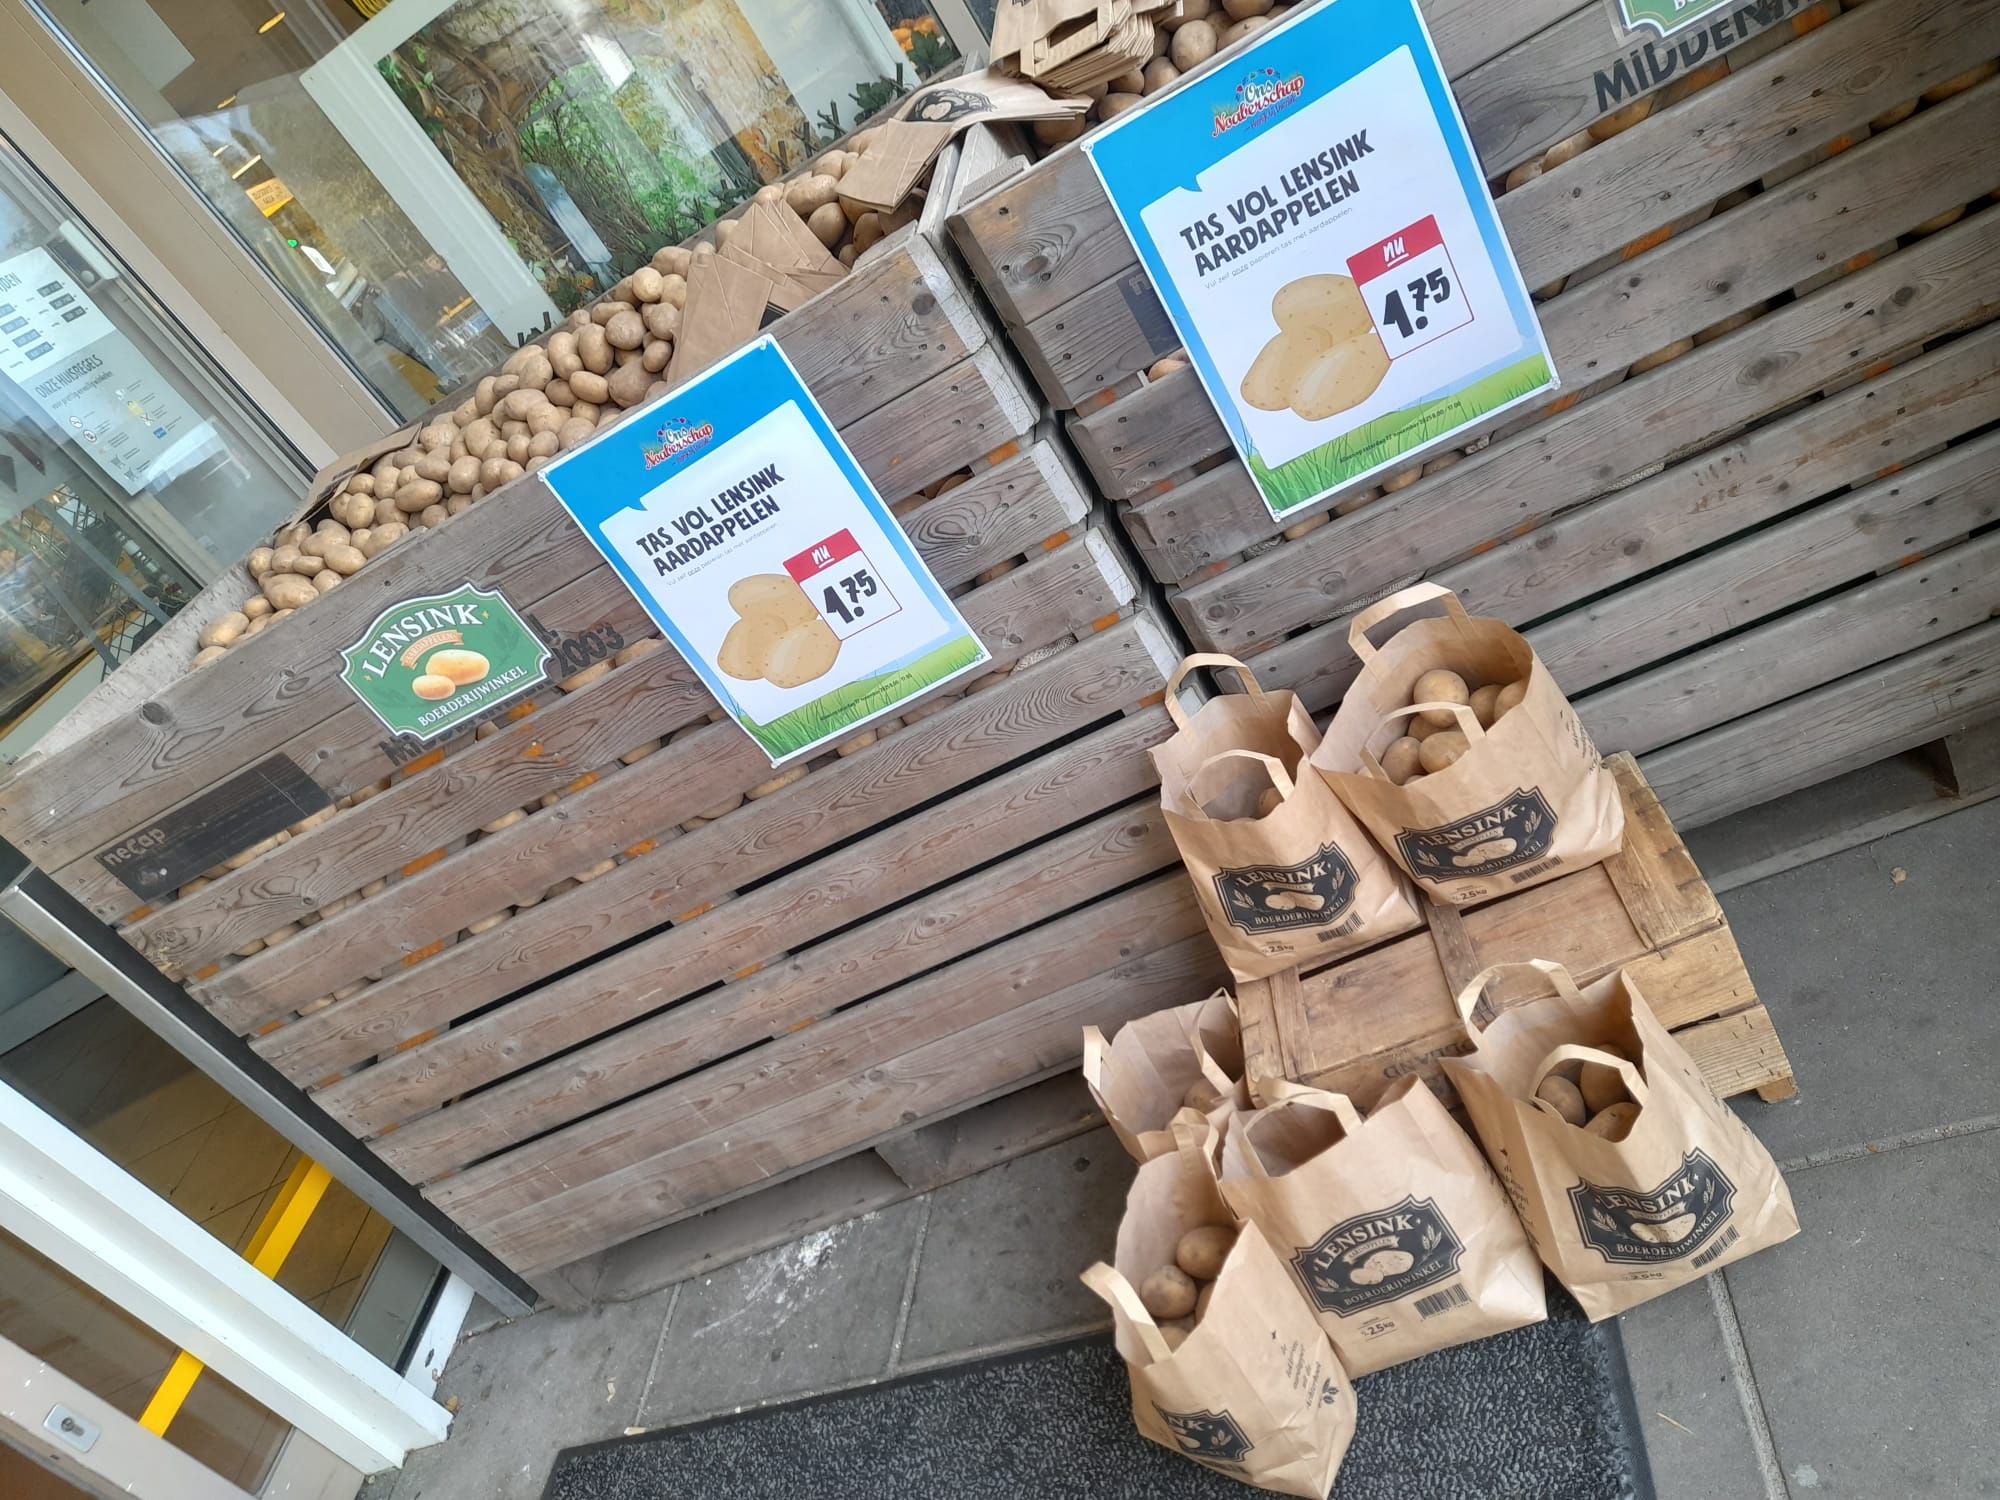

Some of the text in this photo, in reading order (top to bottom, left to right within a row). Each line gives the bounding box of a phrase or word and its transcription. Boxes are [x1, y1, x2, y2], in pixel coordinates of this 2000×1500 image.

[1212, 76, 1305, 137] Noaberschap
[1245, 80, 1273, 103] Ons
[1180, 128, 1375, 251] TAS VOL LENSINK
[1195, 169, 1360, 277] AARDAPPELEN
[1281, 239, 1293, 250] tas
[1293, 231, 1308, 243] met
[1308, 207, 1353, 235] aardappelen
[34, 375, 62, 398] ONZE
[55, 354, 103, 388] HUISREGELS
[645, 423, 714, 470] Noaberschap
[666, 427, 688, 445] Ons
[636, 463, 785, 556] TAS VOL LENSINK
[653, 494, 780, 577] AARDAPPELEN
[362, 604, 483, 678] LENSINK
[417, 666, 527, 727] BOERDERIJWINKEL
[1422, 803, 1519, 847] LENSINK
[1237, 861, 1327, 887] LENSINK
[1254, 897, 1346, 925] BOERDERIJWINKEL
[1599, 1173, 1696, 1213] LENSINK
[1315, 1214, 1415, 1271] LENSINK
[1343, 1261, 1444, 1305] BOERDERIJWINKEL
